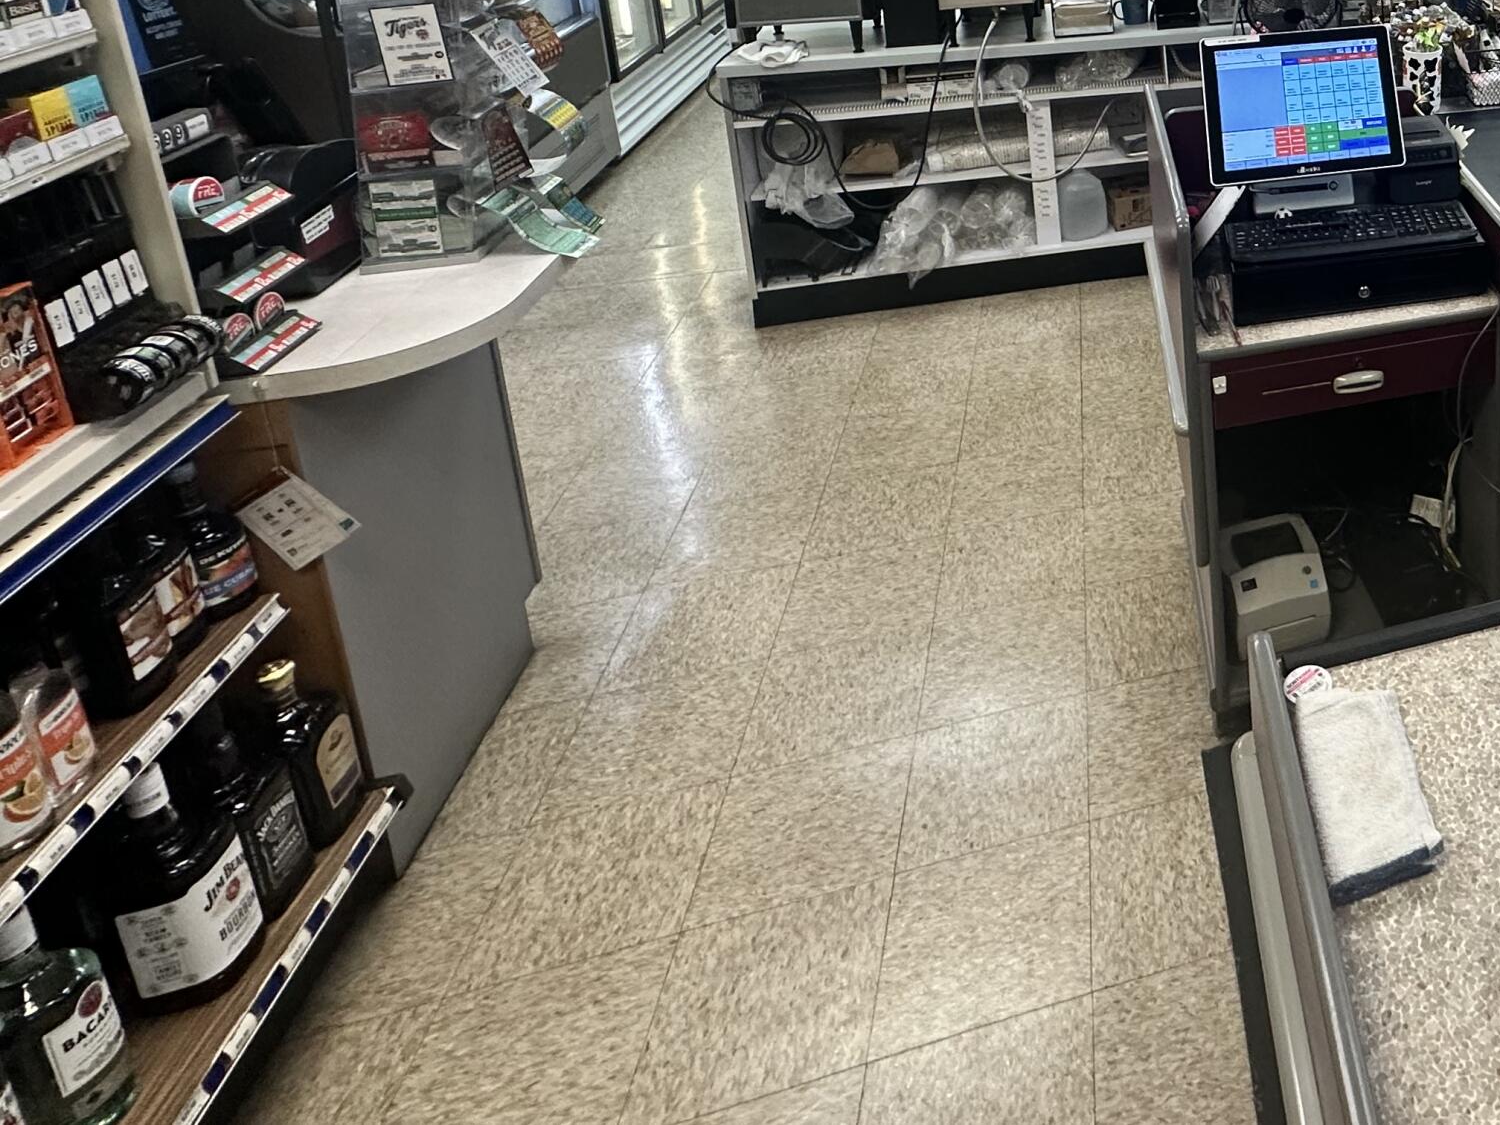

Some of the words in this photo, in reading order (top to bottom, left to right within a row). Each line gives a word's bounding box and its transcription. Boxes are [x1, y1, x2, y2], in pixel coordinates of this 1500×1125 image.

[8, 1, 41, 18] Basic
[384, 16, 429, 39] Tigers
[205, 876, 226, 913] JIM
[219, 889, 256, 941] BOURBON
